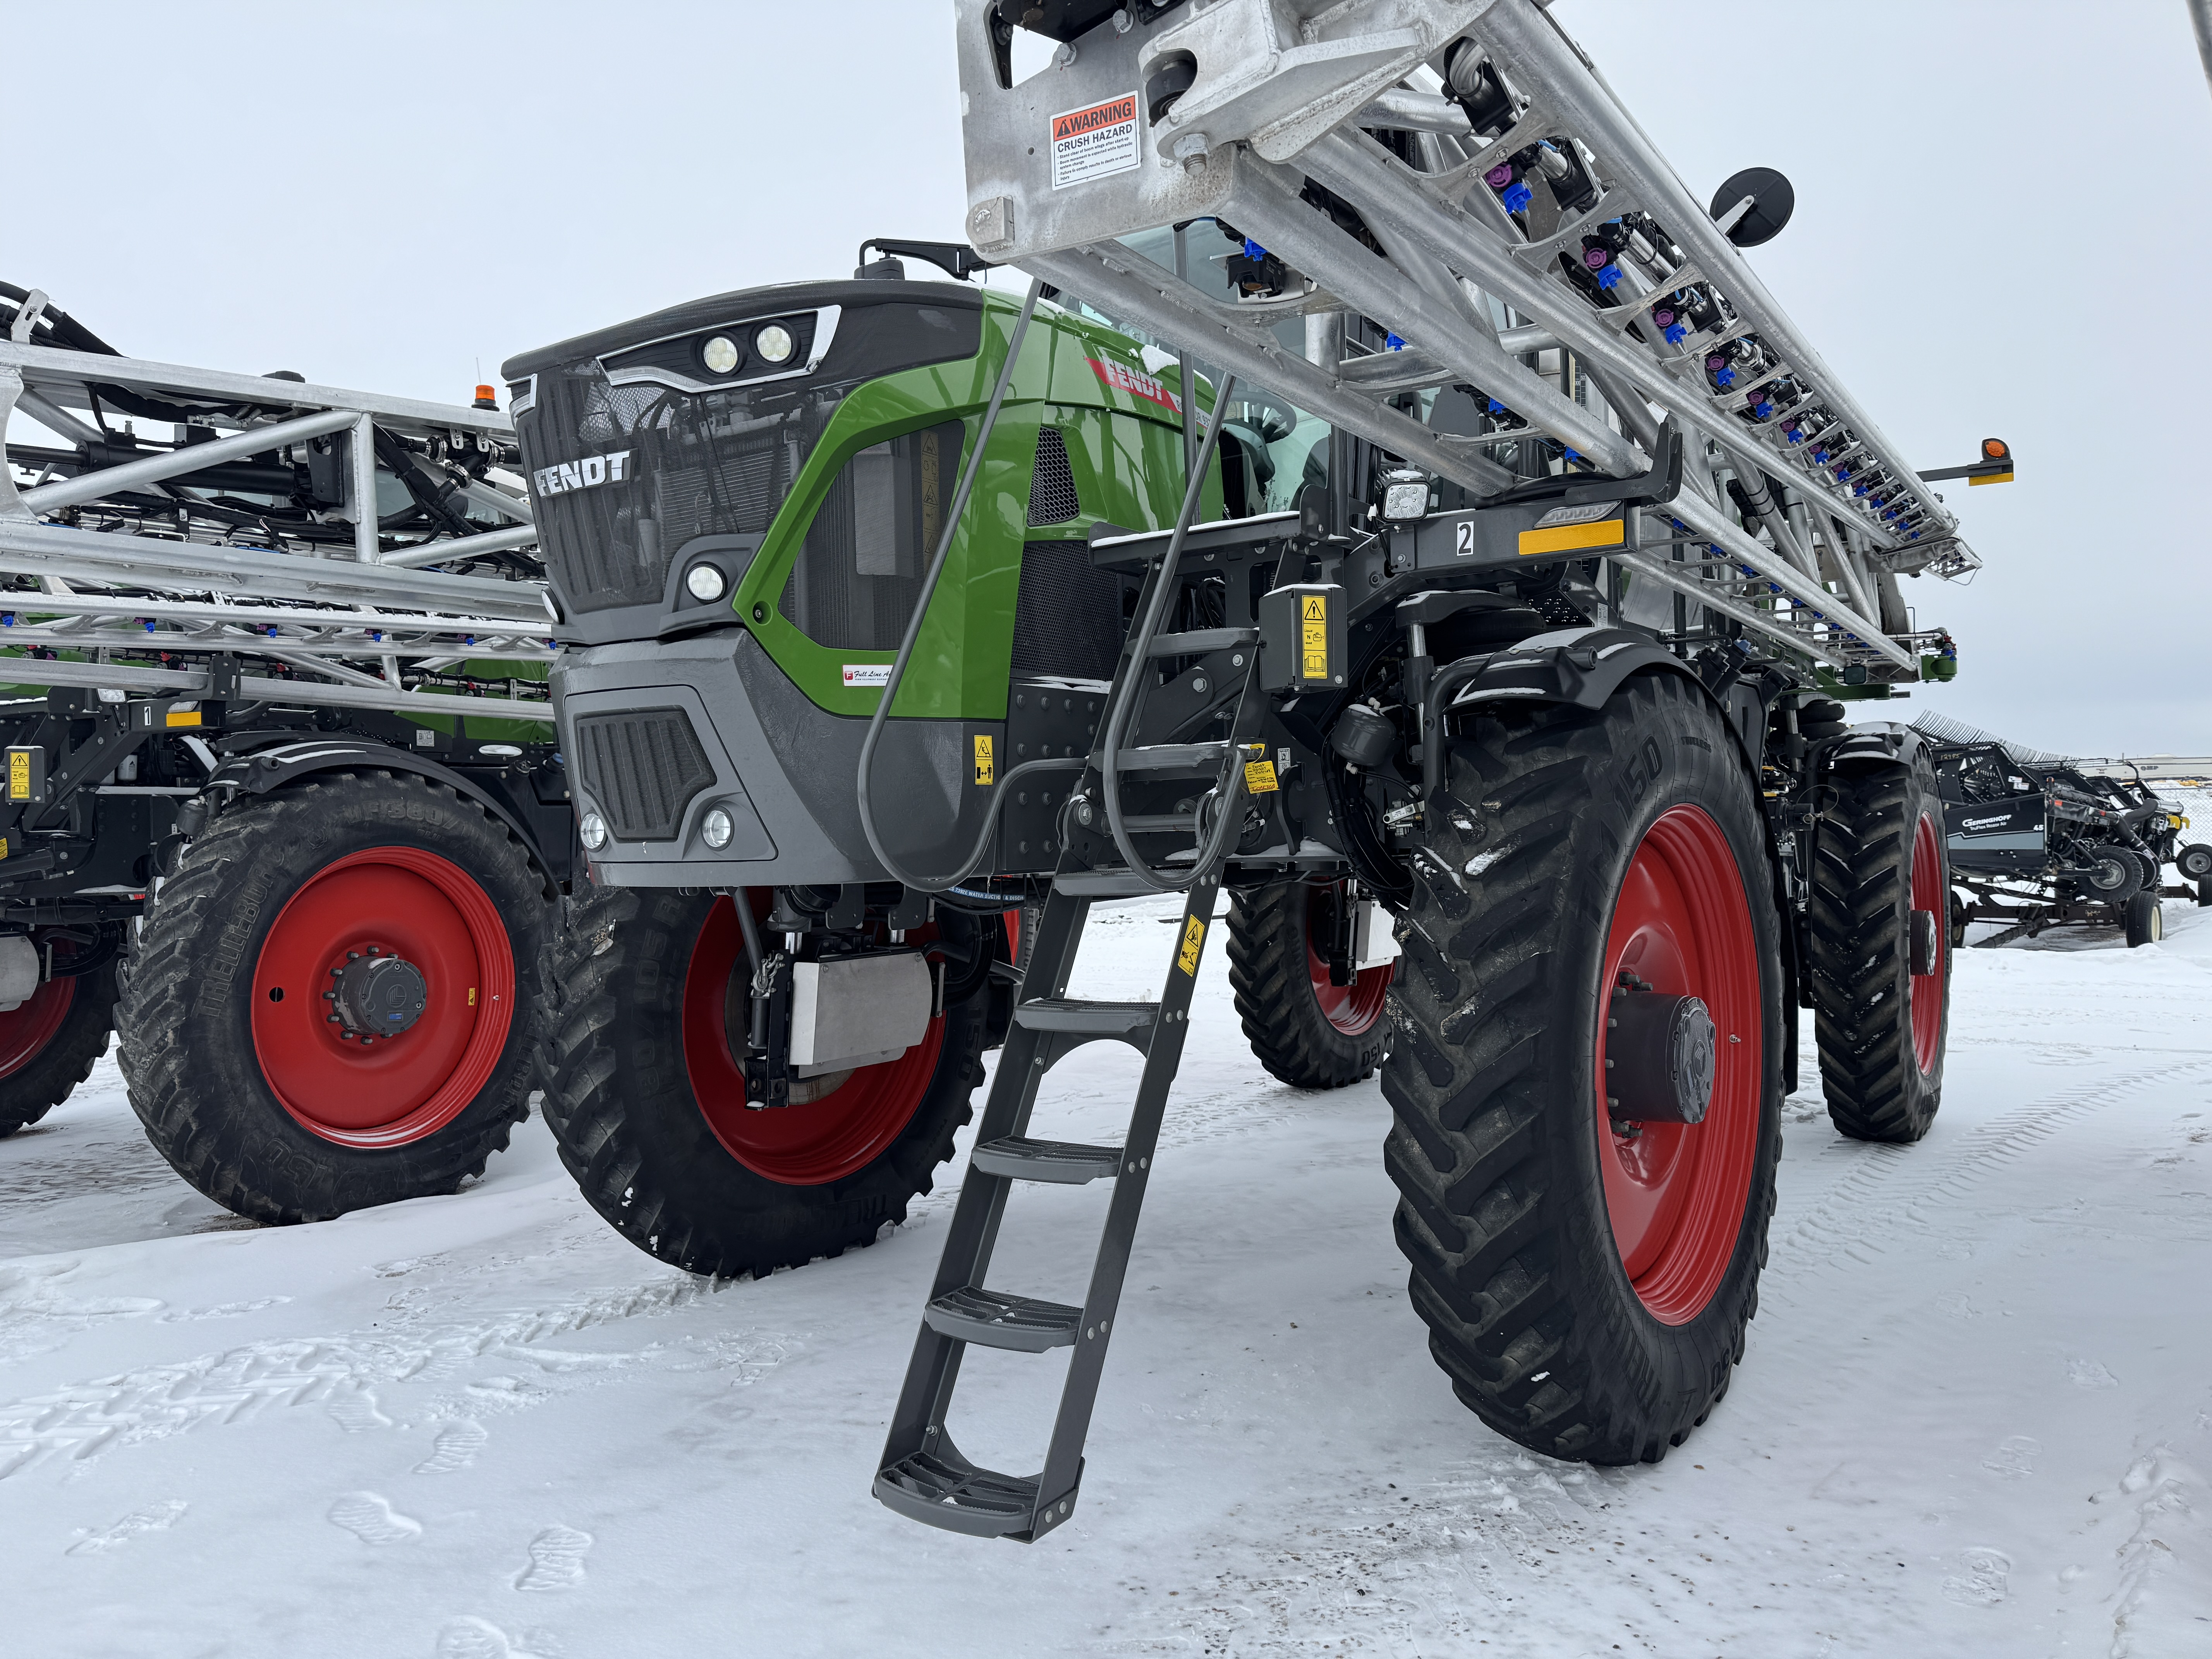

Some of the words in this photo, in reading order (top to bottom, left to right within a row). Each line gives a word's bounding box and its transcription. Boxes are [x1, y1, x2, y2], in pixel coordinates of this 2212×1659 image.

[1070, 102, 1132, 132] WARNING
[1058, 135, 1089, 152] CRUSH
[1093, 124, 1132, 143] HAZARD
[1092, 149, 1107, 157] expected
[1102, 356, 1163, 401] FENDT
[533, 450, 630, 497] FENDT
[1459, 523, 1472, 554] 2
[146, 708, 150, 724] 1
[1962, 814, 2012, 827] GERINGHOFF
[1362, 1042, 1381, 1067] 150
